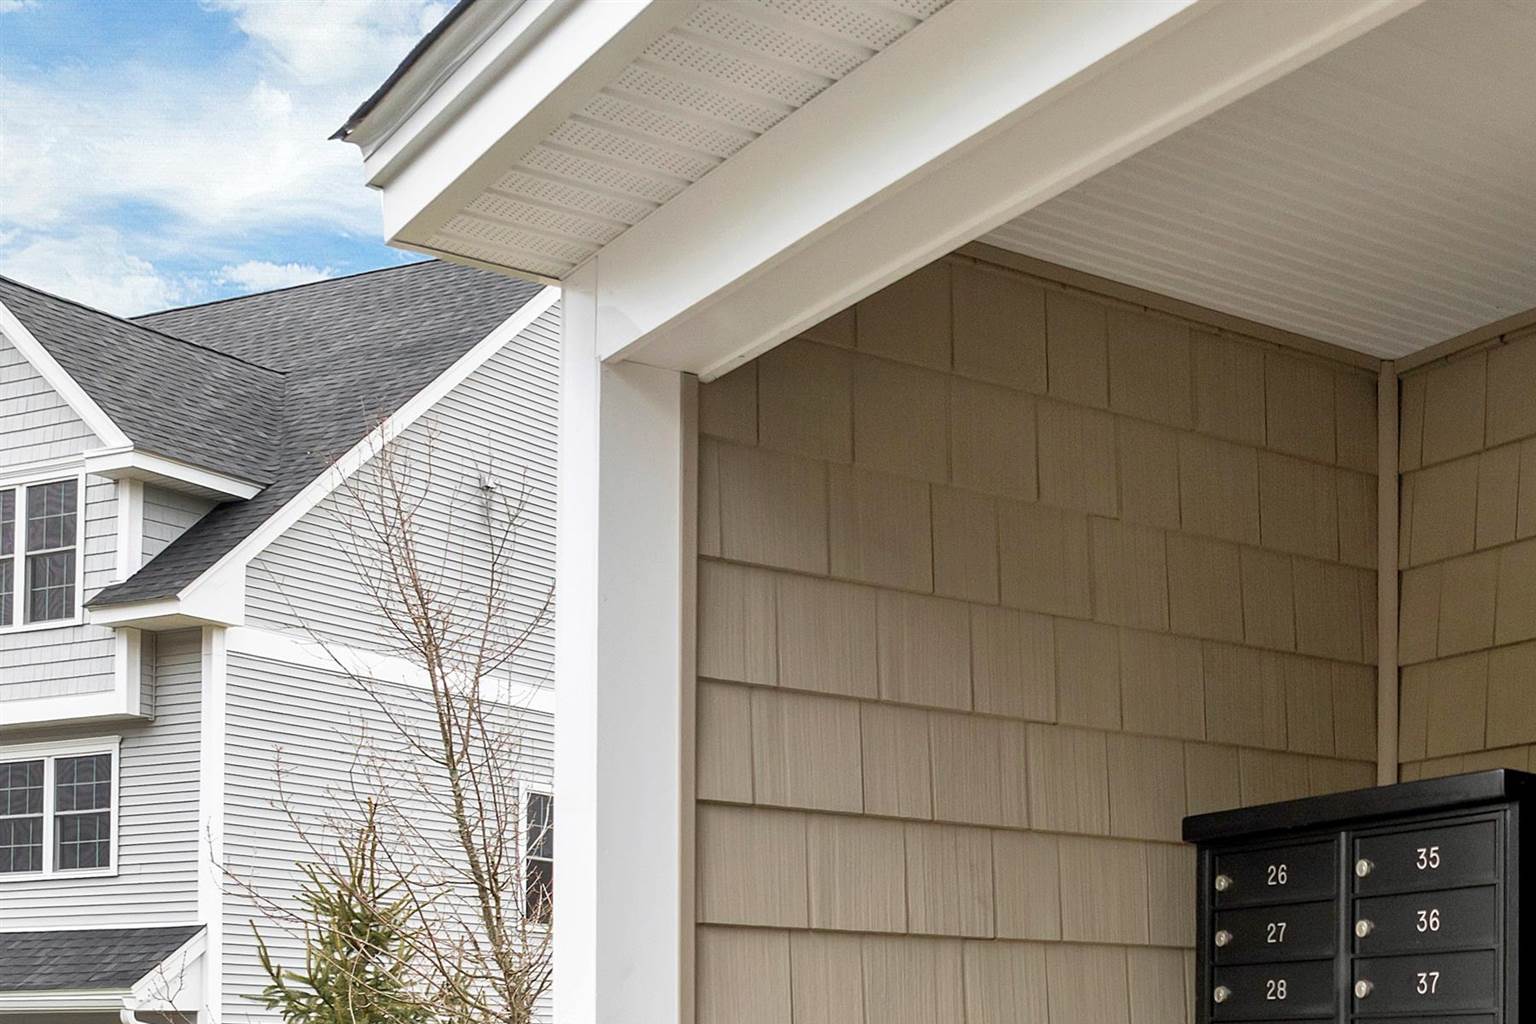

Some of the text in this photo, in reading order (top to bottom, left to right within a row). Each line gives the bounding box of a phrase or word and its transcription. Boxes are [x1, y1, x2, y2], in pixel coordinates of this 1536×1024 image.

[1416, 846, 1440, 870] 35
[1267, 864, 1287, 886] 26
[1416, 908, 1440, 933] 36
[1267, 922, 1287, 943] 27
[1266, 979, 1287, 1000] 28
[1416, 971, 1440, 995] 37
